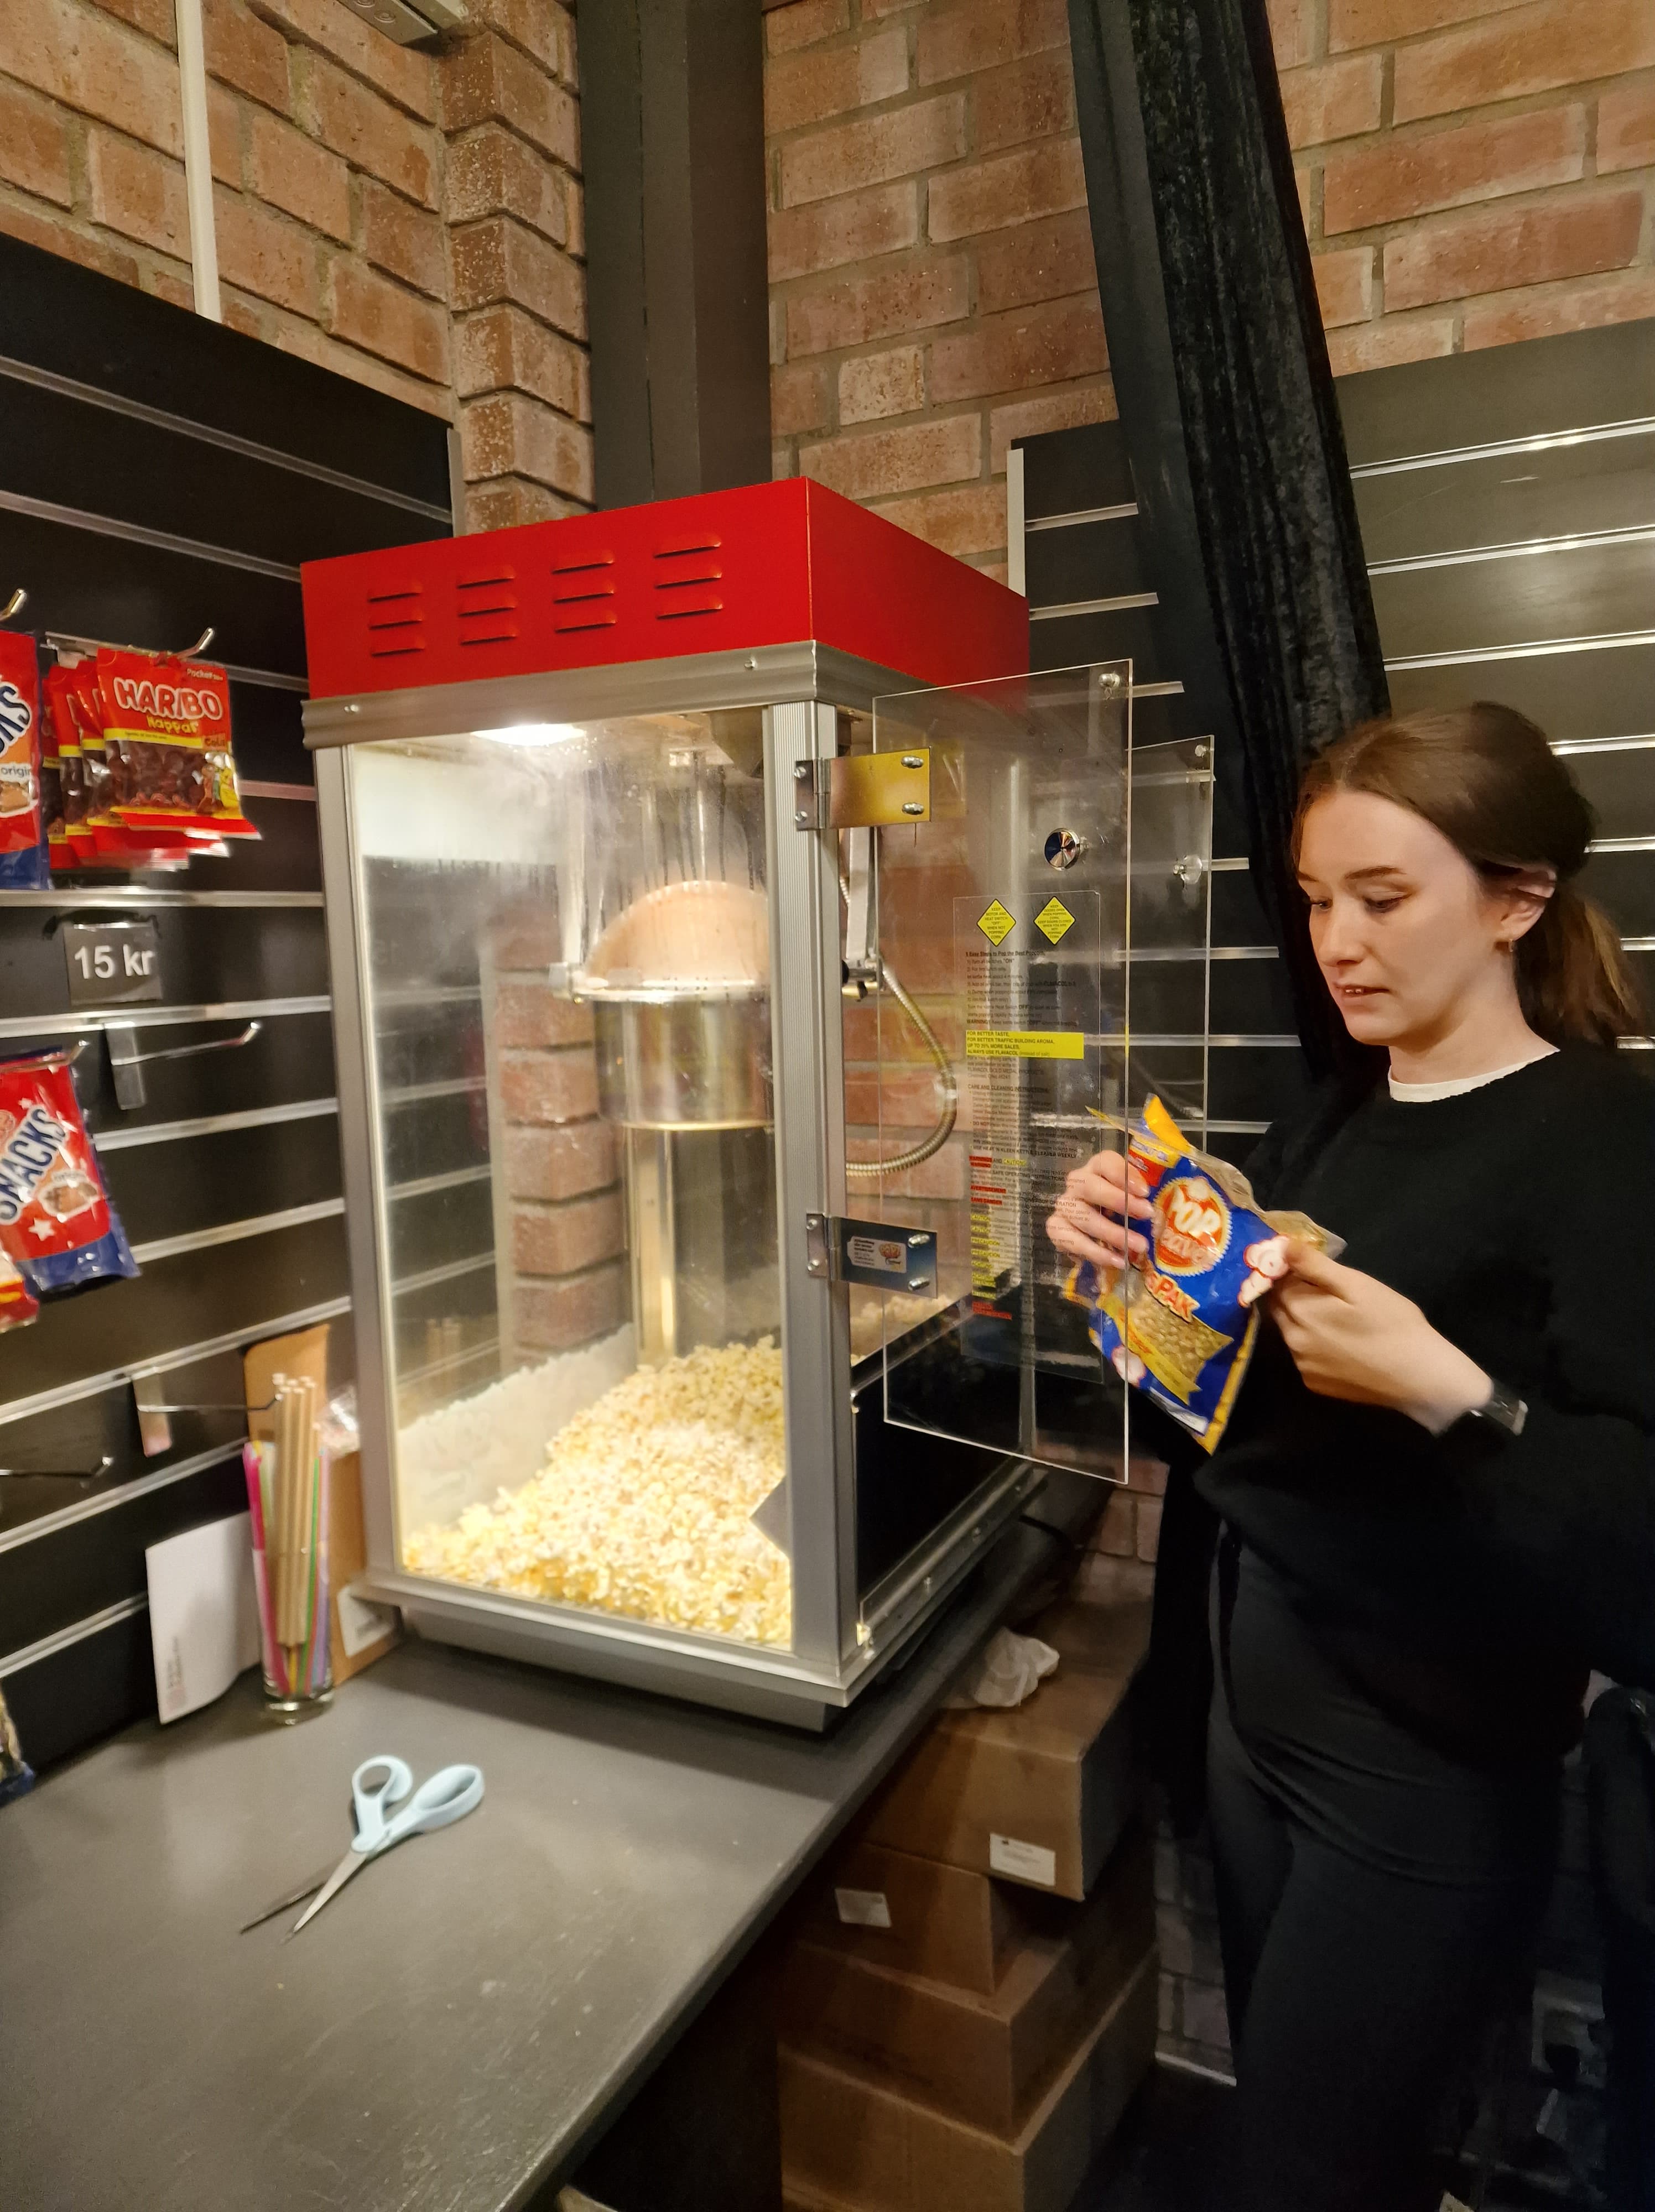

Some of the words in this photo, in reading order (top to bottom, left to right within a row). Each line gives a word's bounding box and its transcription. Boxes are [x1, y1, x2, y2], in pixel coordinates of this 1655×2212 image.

[113, 676, 222, 721] HARIBO
[147, 715, 199, 734] Nappar
[74, 944, 115, 979] 15
[122, 943, 154, 977] kr
